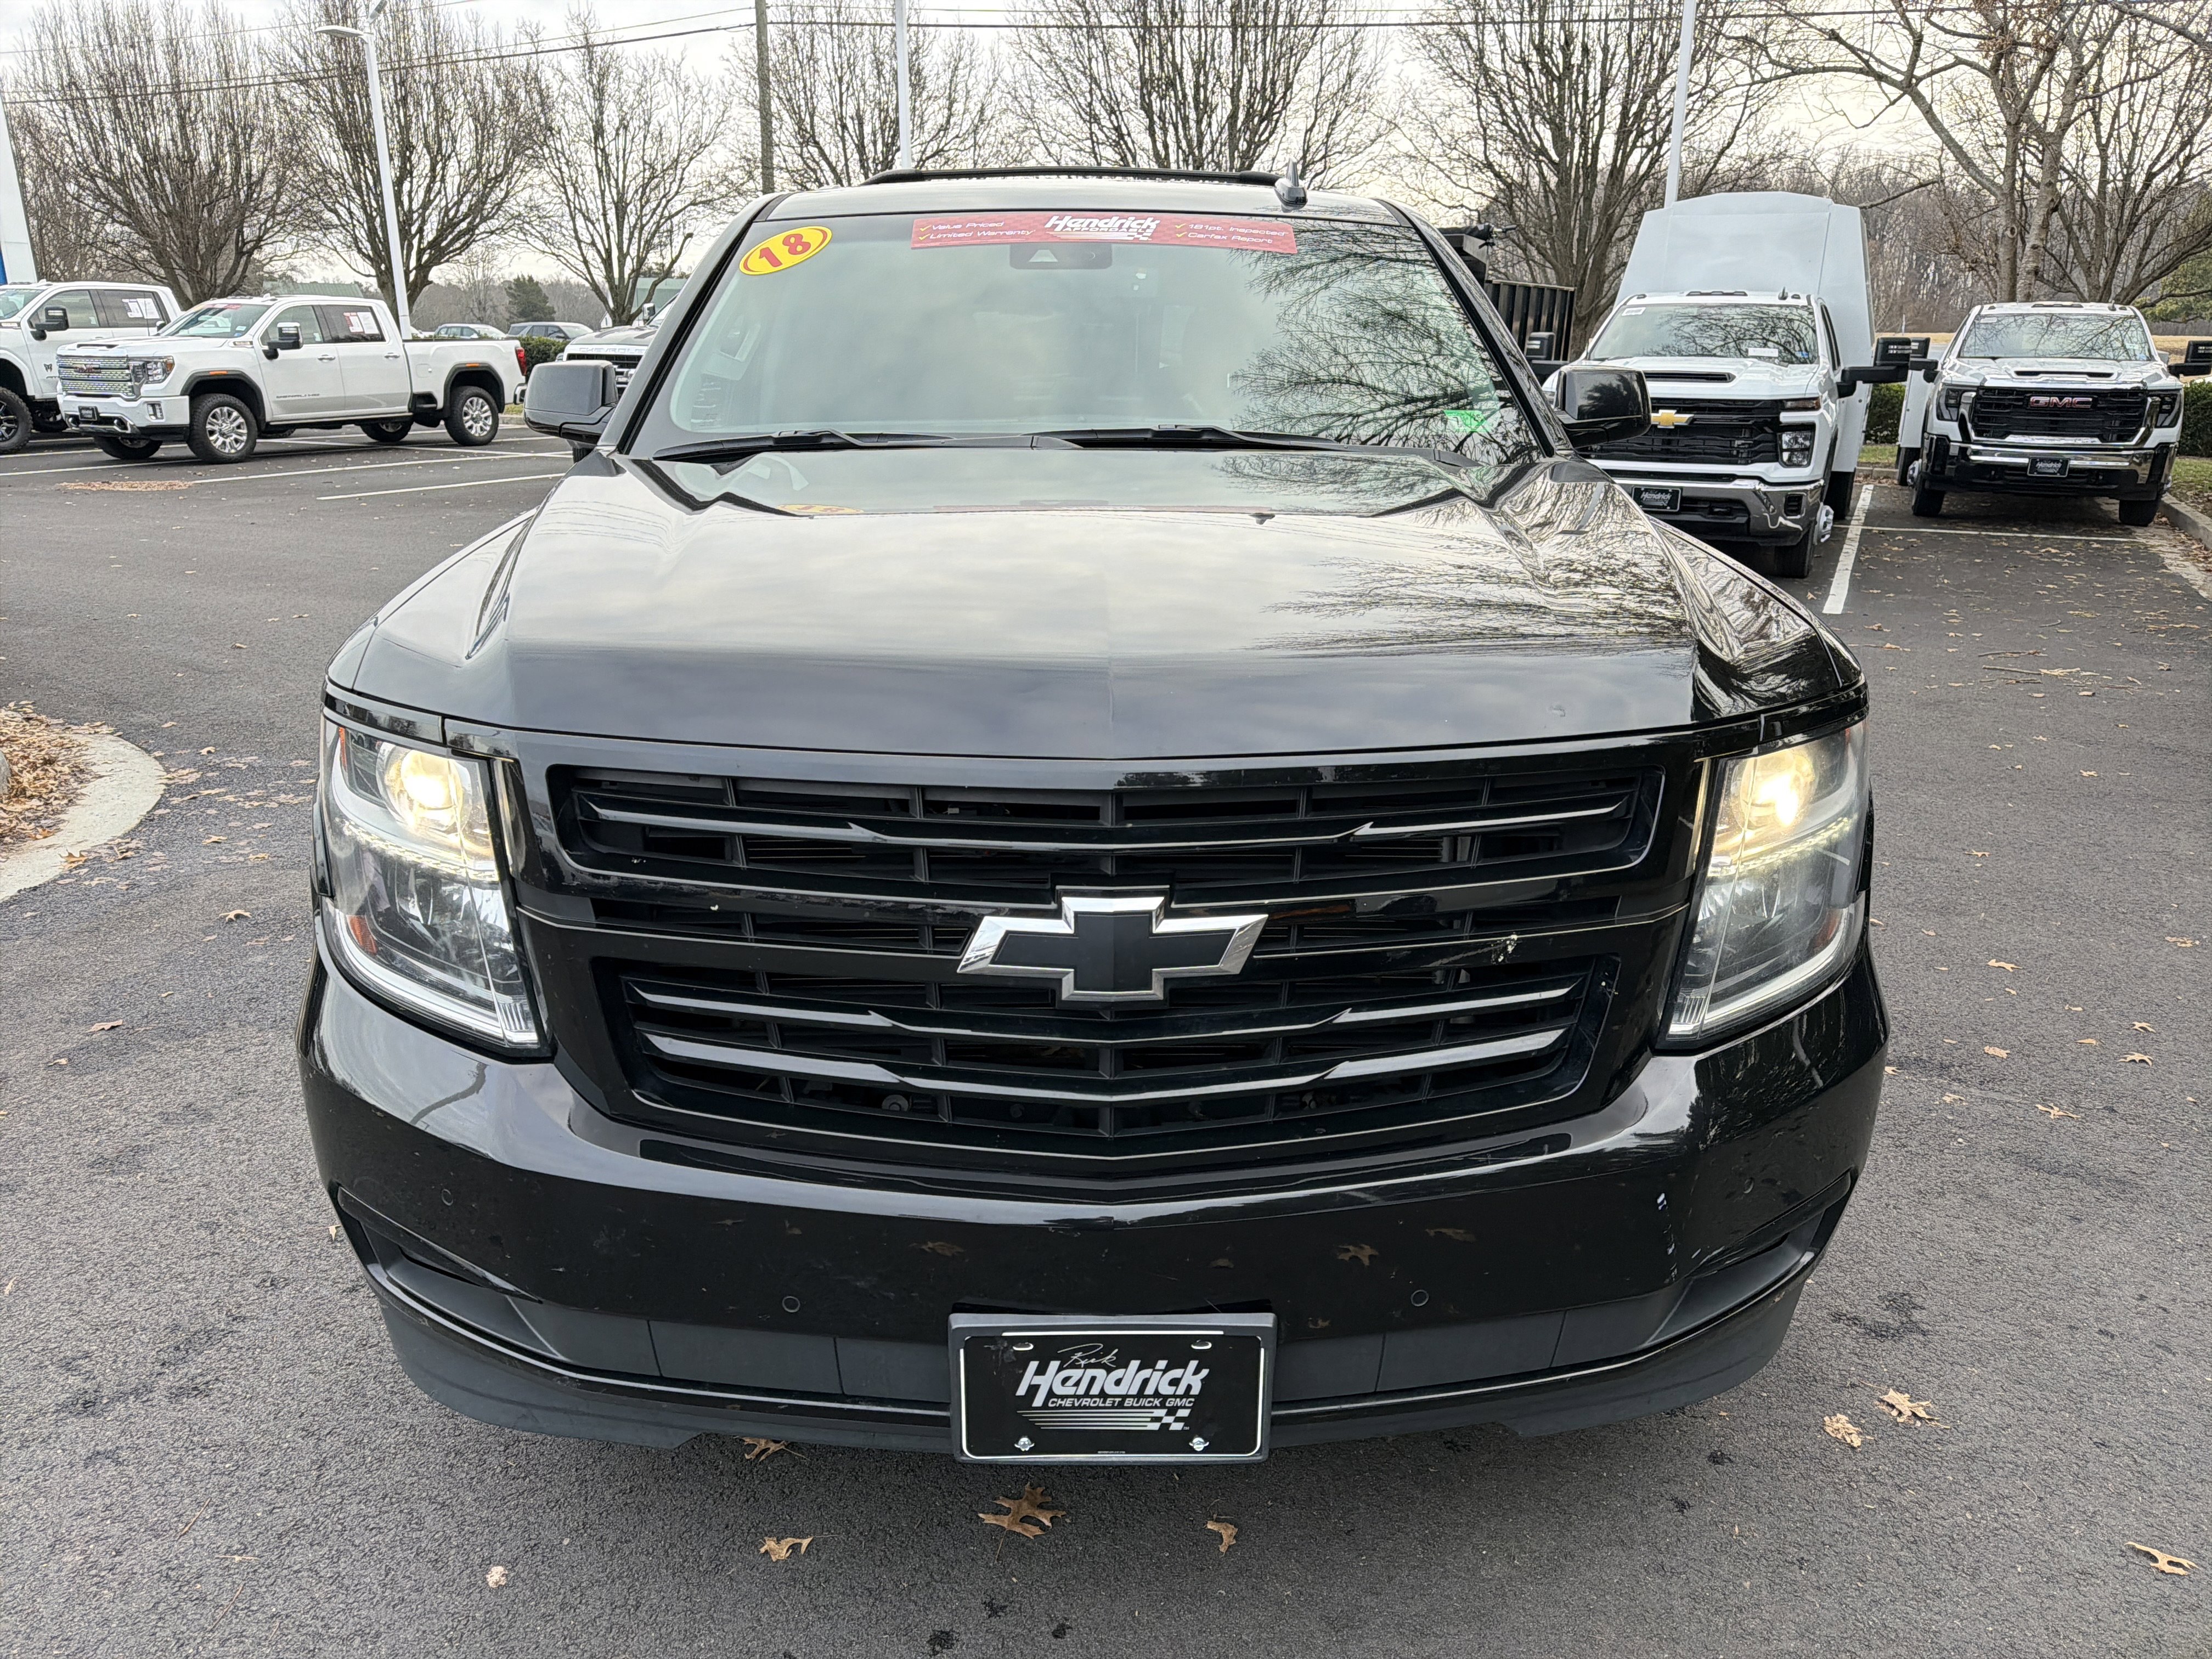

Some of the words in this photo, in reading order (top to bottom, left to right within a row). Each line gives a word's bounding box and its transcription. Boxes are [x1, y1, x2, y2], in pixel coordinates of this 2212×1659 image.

[1045, 216, 1160, 232] Hendrick
[1231, 235, 1273, 244] Report
[758, 233, 811, 268] 18
[2030, 396, 2092, 408] GMC
[1015, 1360, 1210, 1407] Hendrick
[1048, 1398, 1122, 1407] CHEVROLET
[1124, 1398, 1161, 1407] BUICK
[1166, 1398, 1195, 1407] GMC
